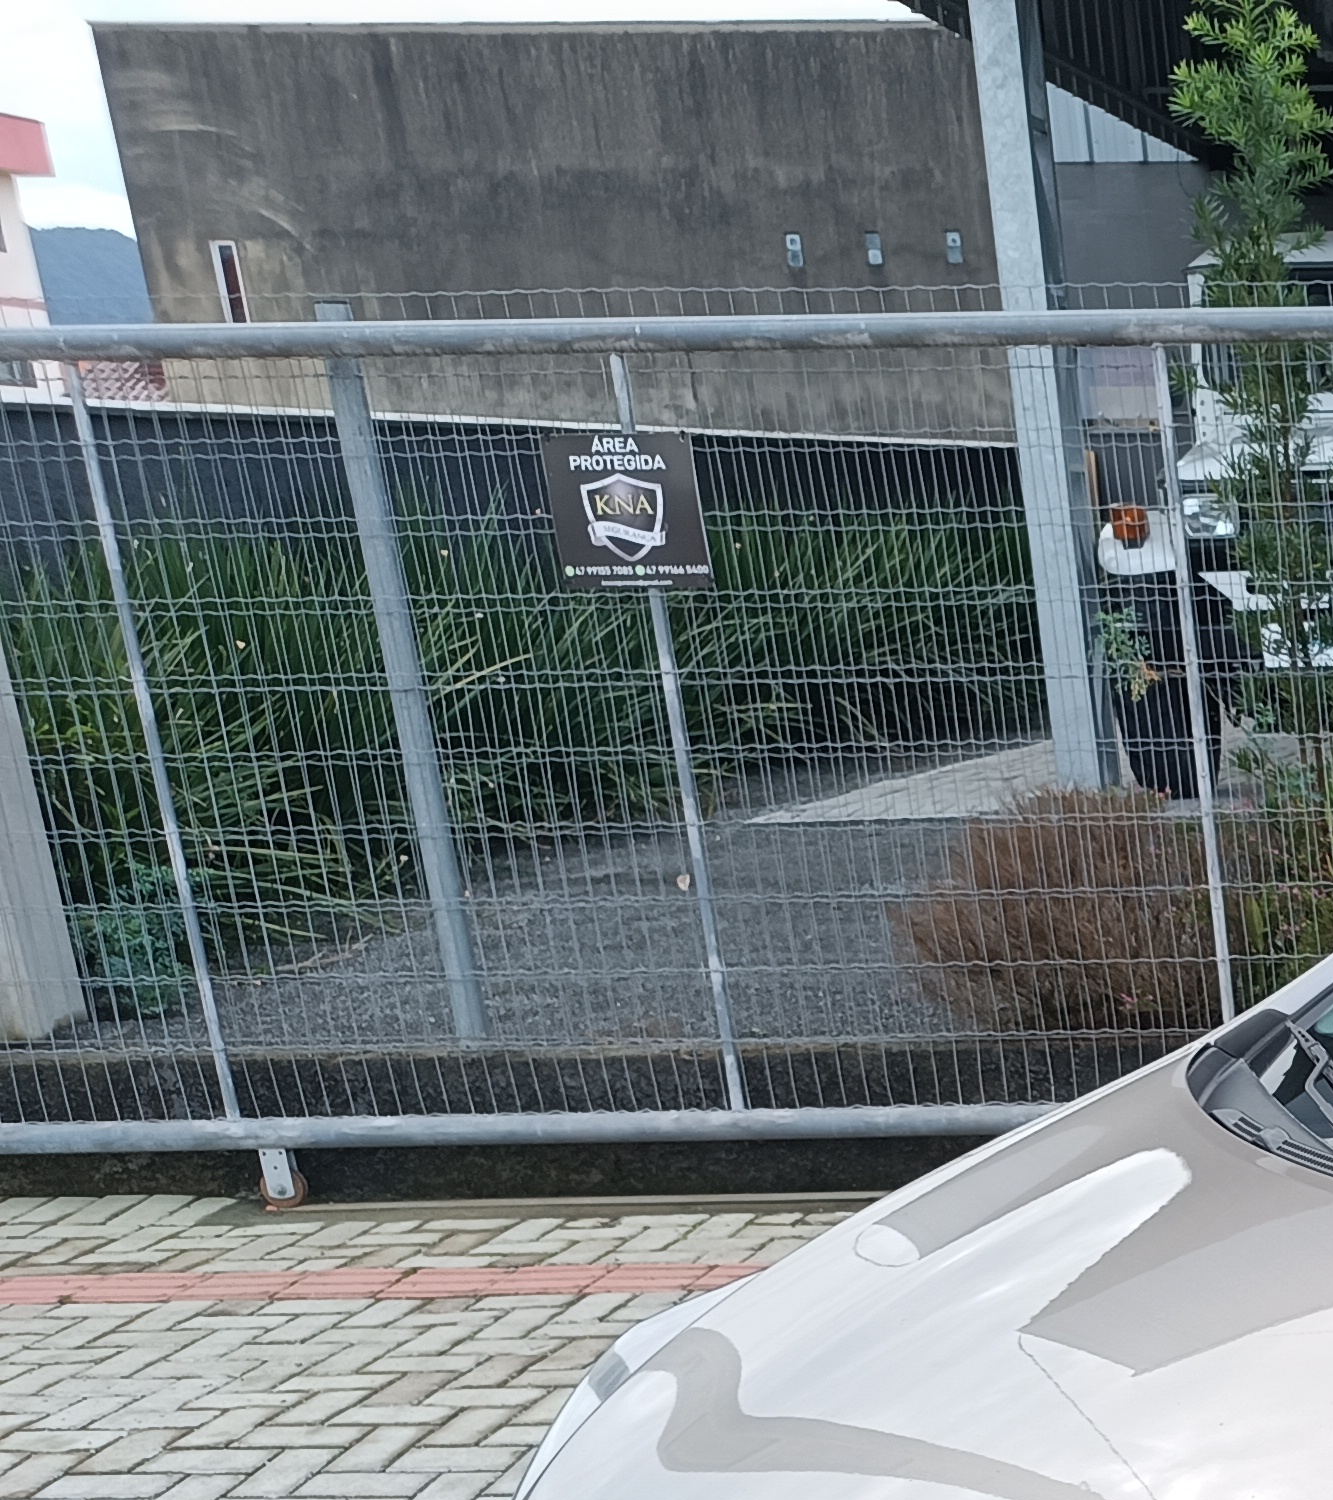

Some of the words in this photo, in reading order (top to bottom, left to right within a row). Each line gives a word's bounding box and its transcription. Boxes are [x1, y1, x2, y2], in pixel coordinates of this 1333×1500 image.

[591, 435, 639, 453] ÁREA
[569, 454, 667, 471] PROTEGIDA
[594, 493, 654, 515] KNA
